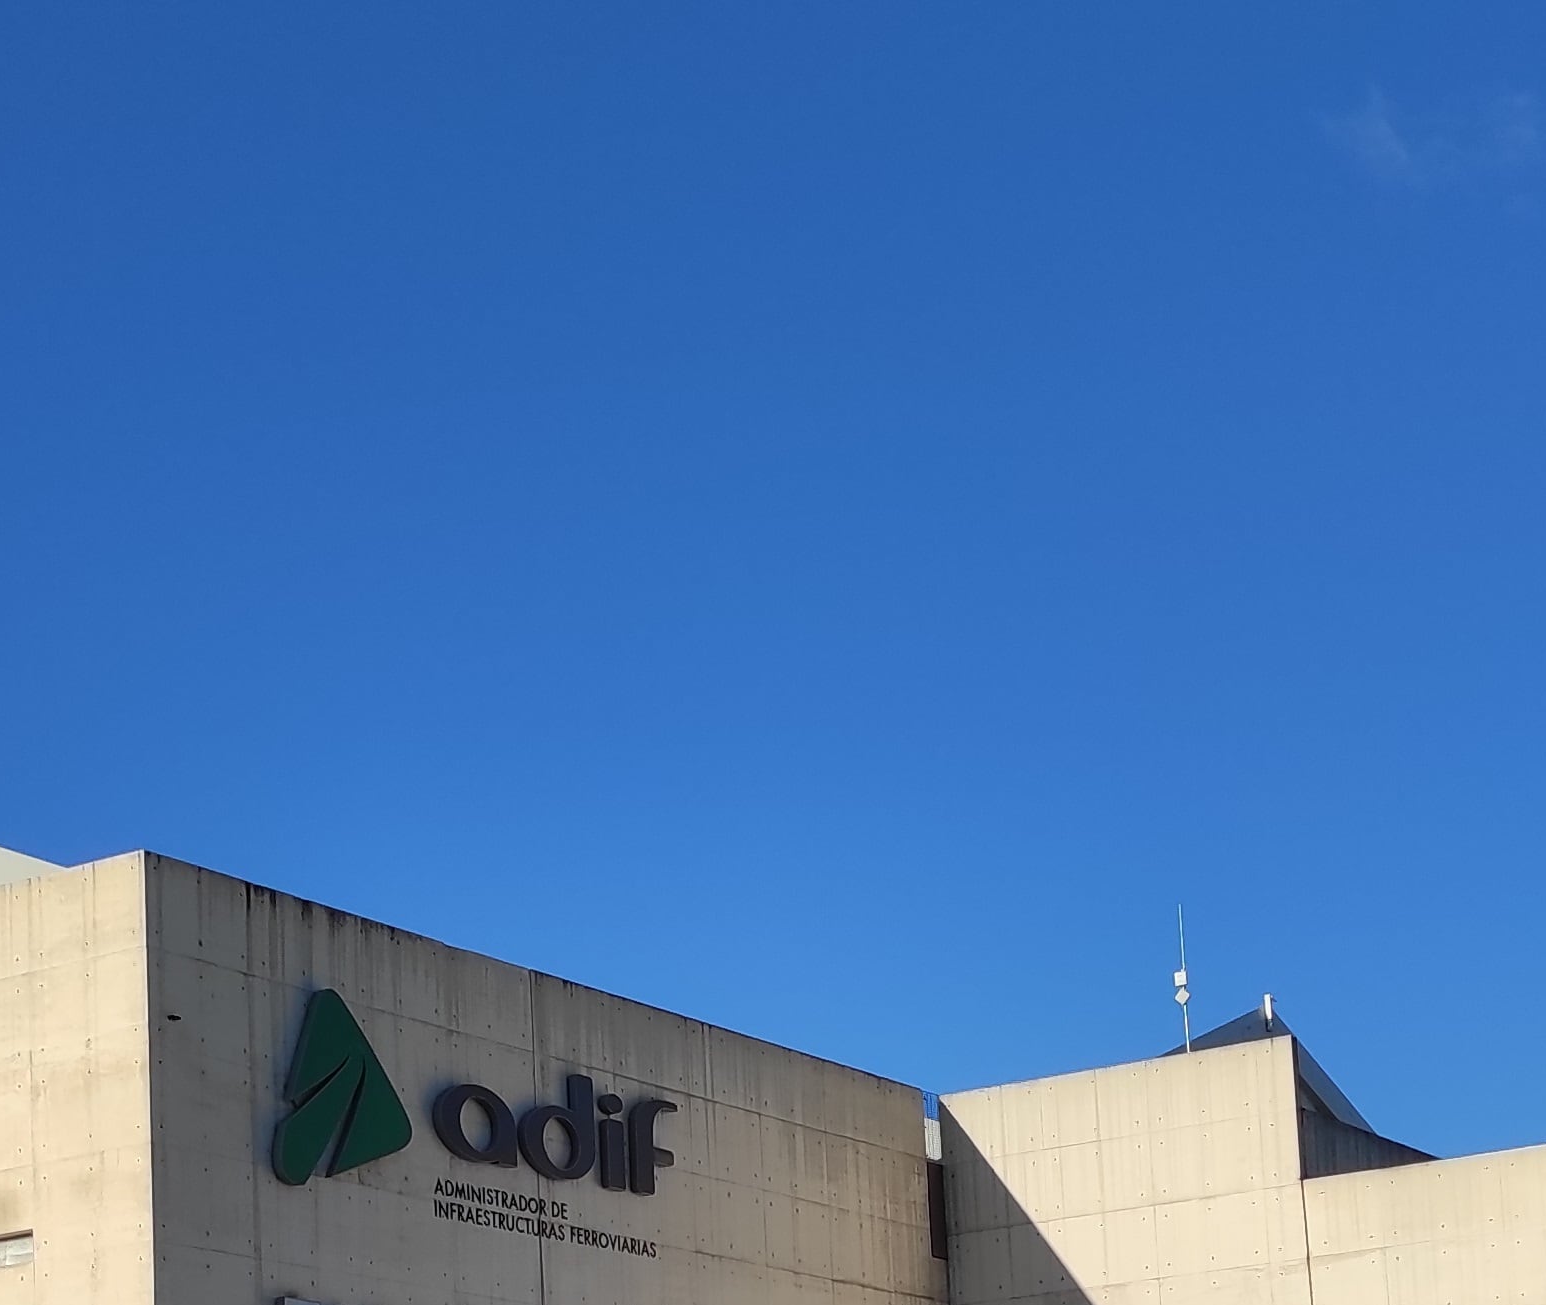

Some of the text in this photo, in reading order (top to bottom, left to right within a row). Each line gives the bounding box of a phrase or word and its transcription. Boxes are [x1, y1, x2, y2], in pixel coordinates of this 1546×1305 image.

[432, 1073, 678, 1197] adif
[433, 1177, 569, 1221] ADMINISTRADOR DE
[433, 1199, 658, 1259] INFRAESTRUCTURAS FERROVIARIAS
